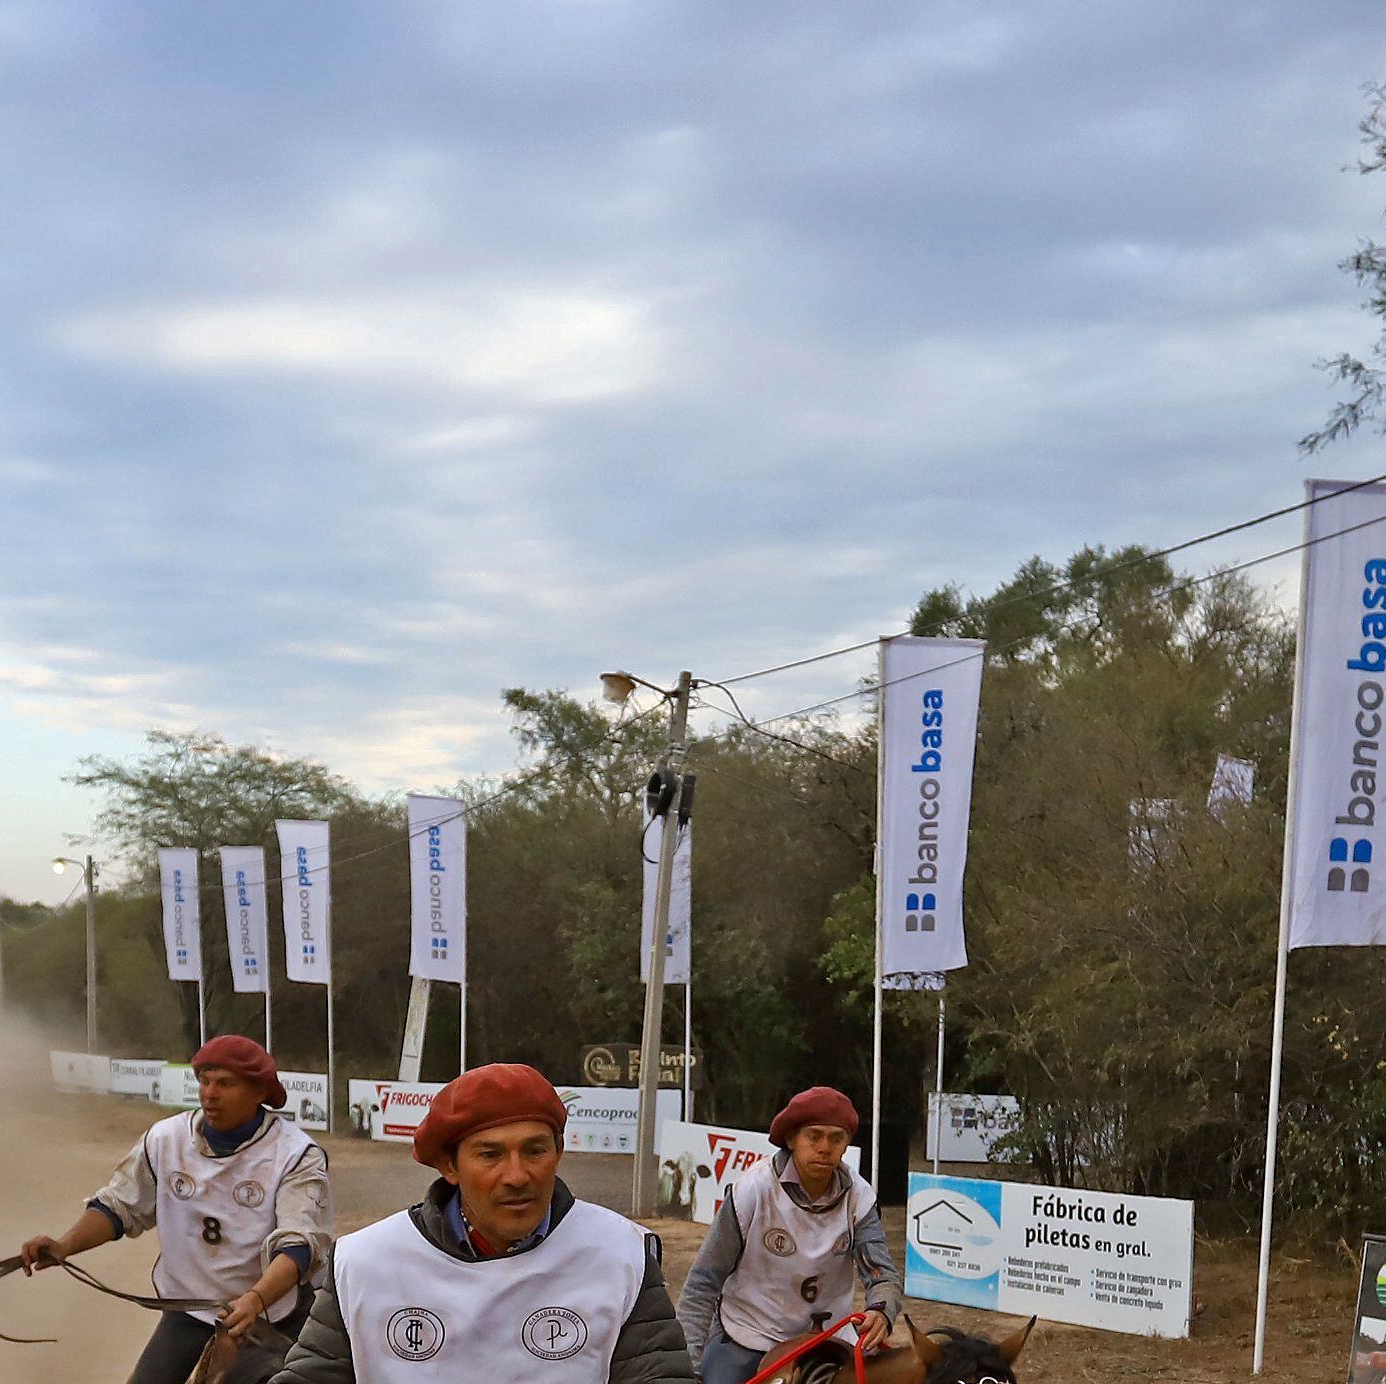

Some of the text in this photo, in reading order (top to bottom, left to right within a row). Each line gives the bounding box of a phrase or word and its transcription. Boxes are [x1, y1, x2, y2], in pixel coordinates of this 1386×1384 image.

[1033, 1192, 1137, 1227] Fábrica de
[202, 1216, 222, 1246] 8
[1025, 1223, 1152, 1259] piletas en gral.
[800, 1275, 818, 1303] 6
